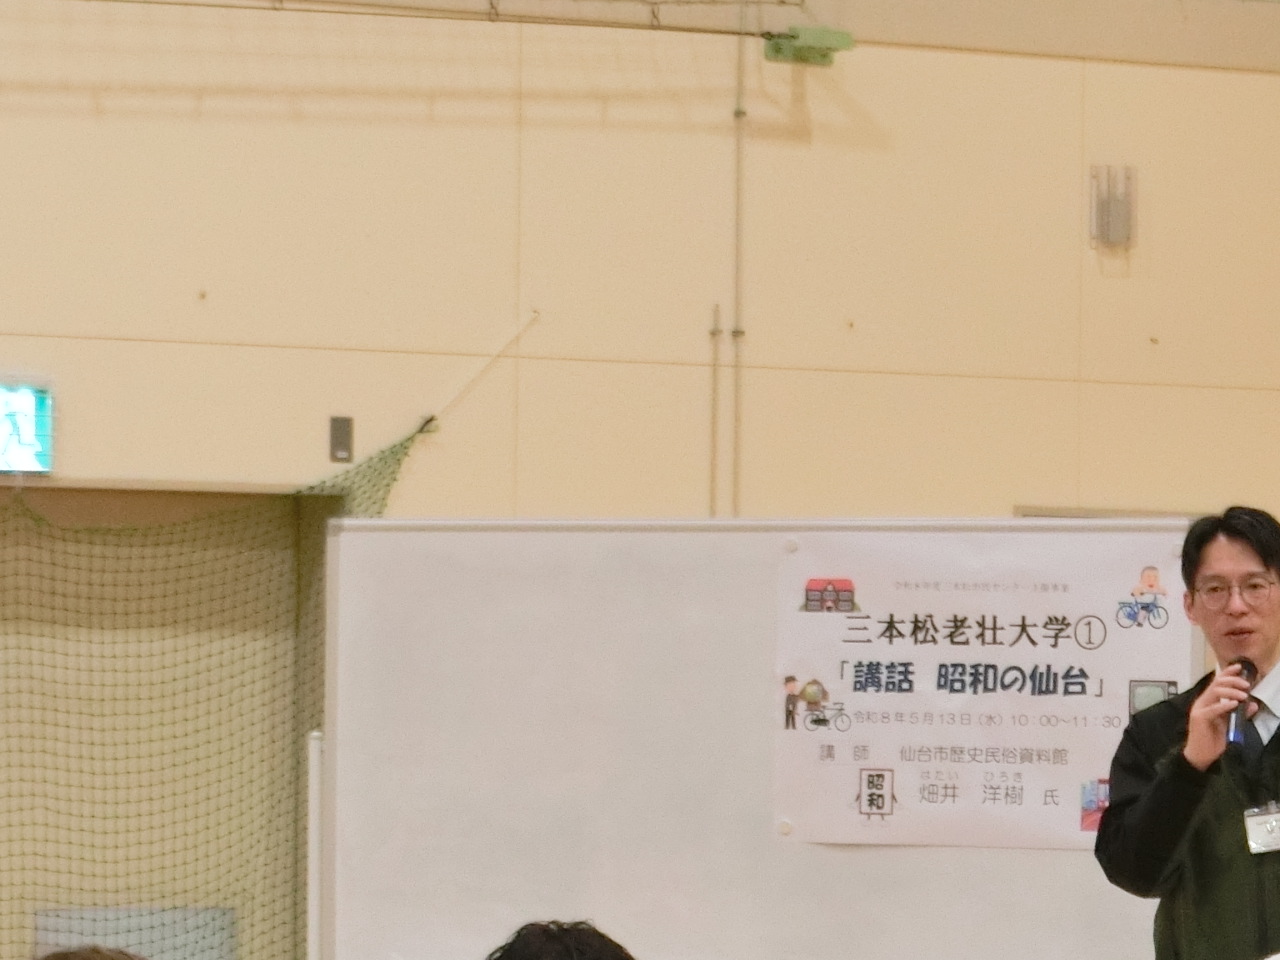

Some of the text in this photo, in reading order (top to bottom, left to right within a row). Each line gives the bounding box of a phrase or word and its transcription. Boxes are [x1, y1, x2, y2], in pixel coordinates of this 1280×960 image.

[842, 613, 1107, 650] 三本松老壮大学①
[899, 745, 1069, 765] 仙台市歴史民俗資料館
[867, 773, 885, 811] 昭和
[919, 783, 1060, 806] 畑井 洋樹 氏
